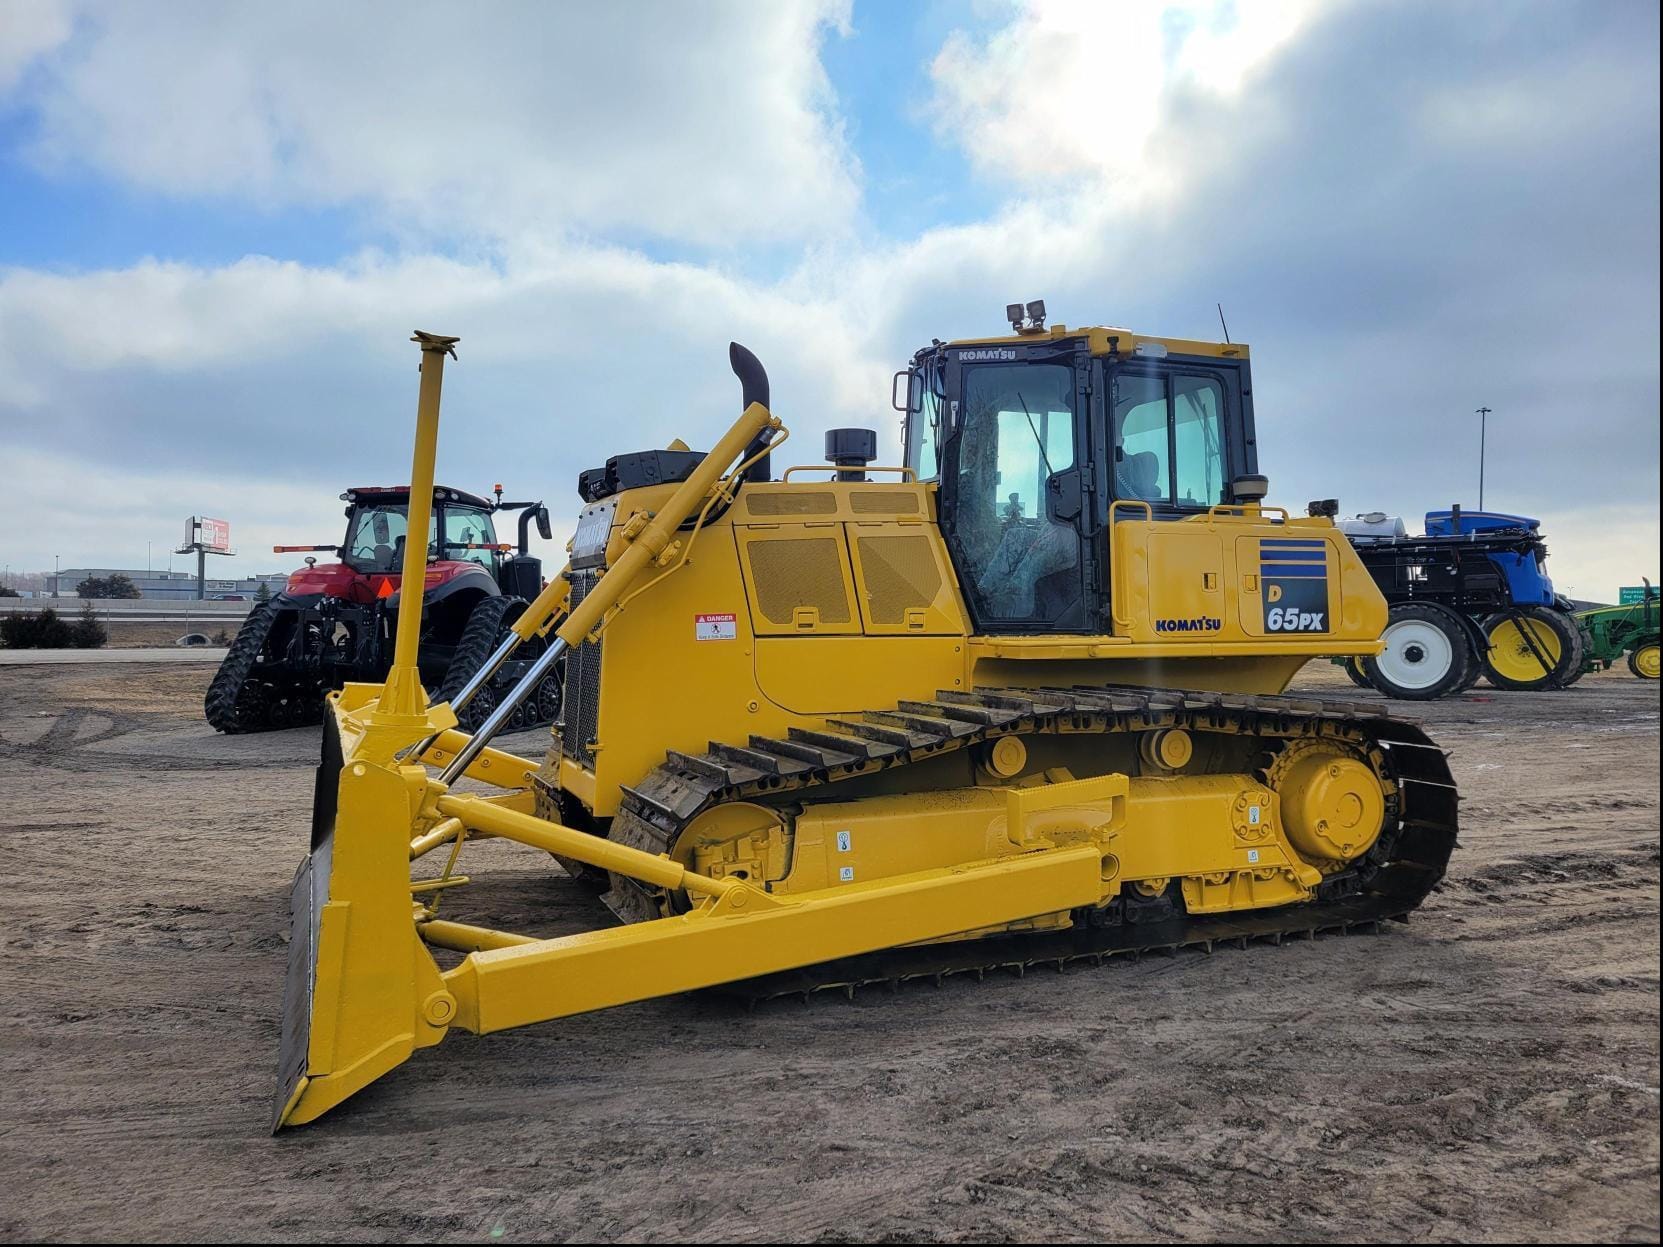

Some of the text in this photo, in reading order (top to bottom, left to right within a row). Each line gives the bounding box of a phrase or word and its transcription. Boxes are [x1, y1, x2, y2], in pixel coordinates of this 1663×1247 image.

[958, 348, 1016, 360] KOMATSU
[1267, 584, 1282, 603] D
[1155, 616, 1221, 631] KOMATSU
[1267, 607, 1324, 631] 65PX
